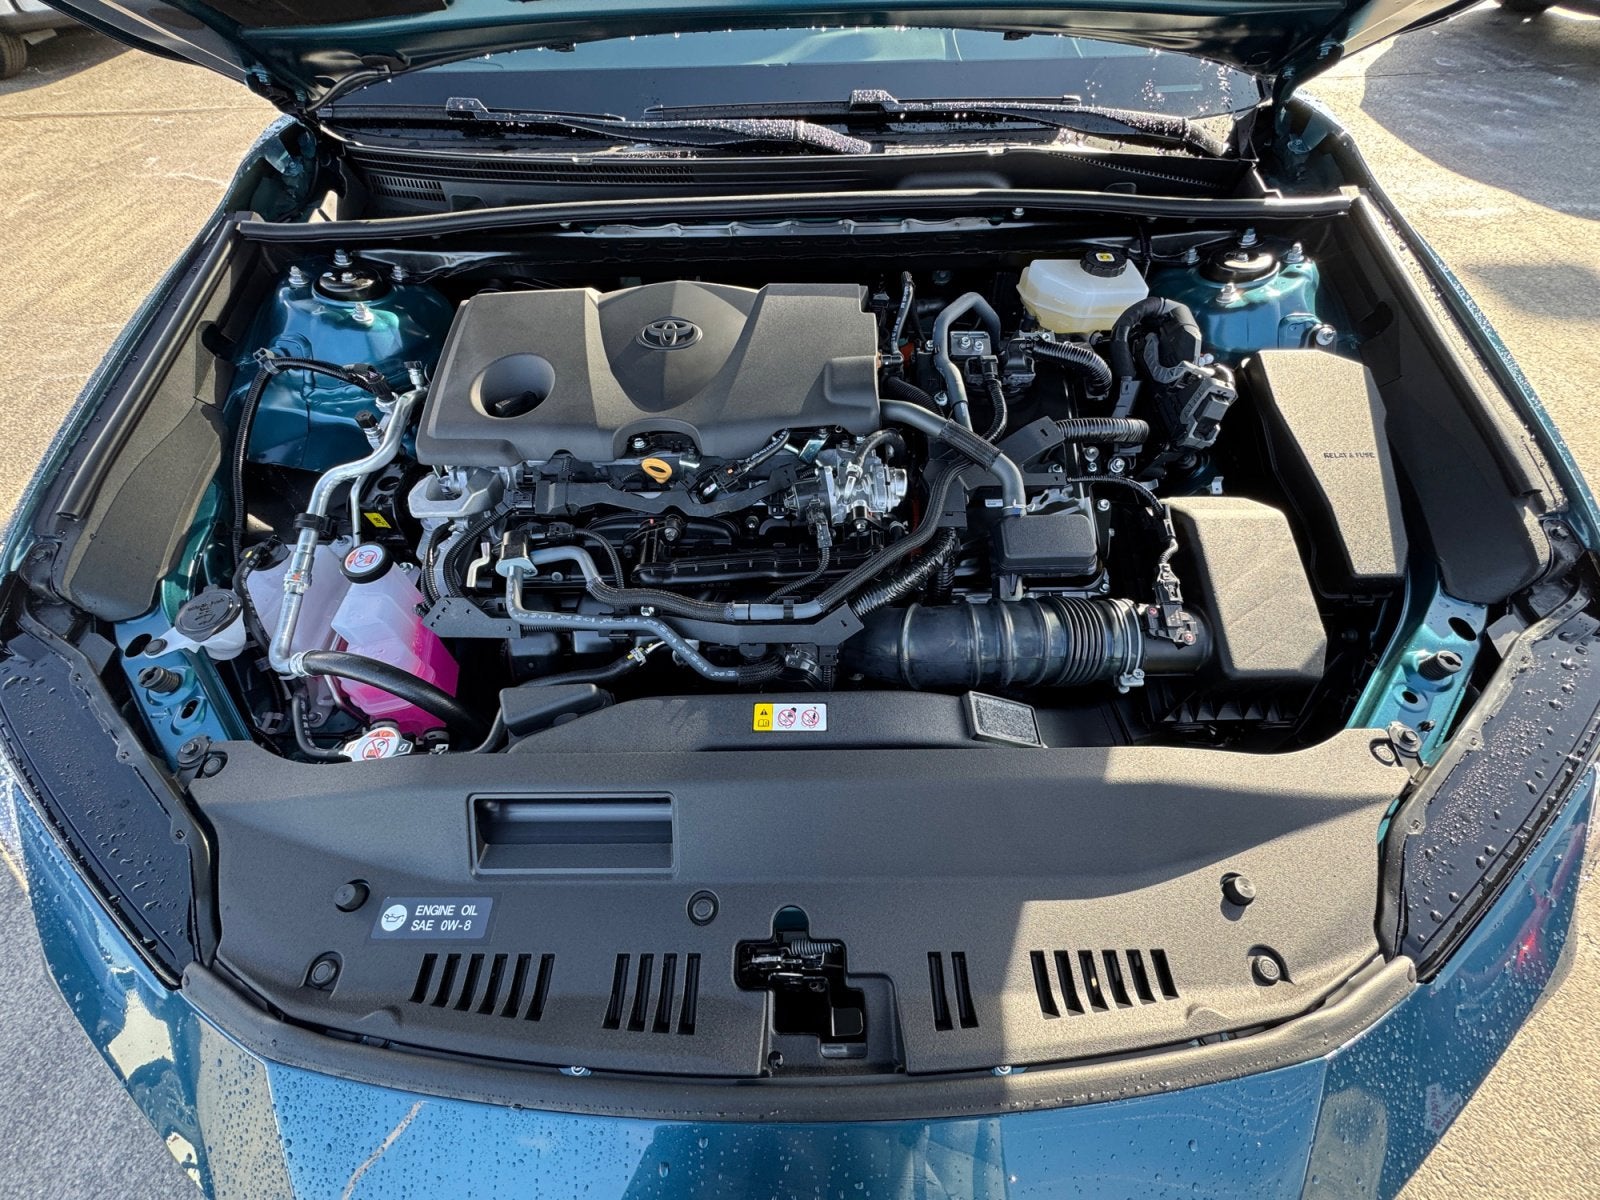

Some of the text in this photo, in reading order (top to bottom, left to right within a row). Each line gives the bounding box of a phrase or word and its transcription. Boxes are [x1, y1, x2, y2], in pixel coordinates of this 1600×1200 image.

[415, 905, 478, 916] ENGINE OIL
[410, 919, 472, 931] SAE 0W-8
